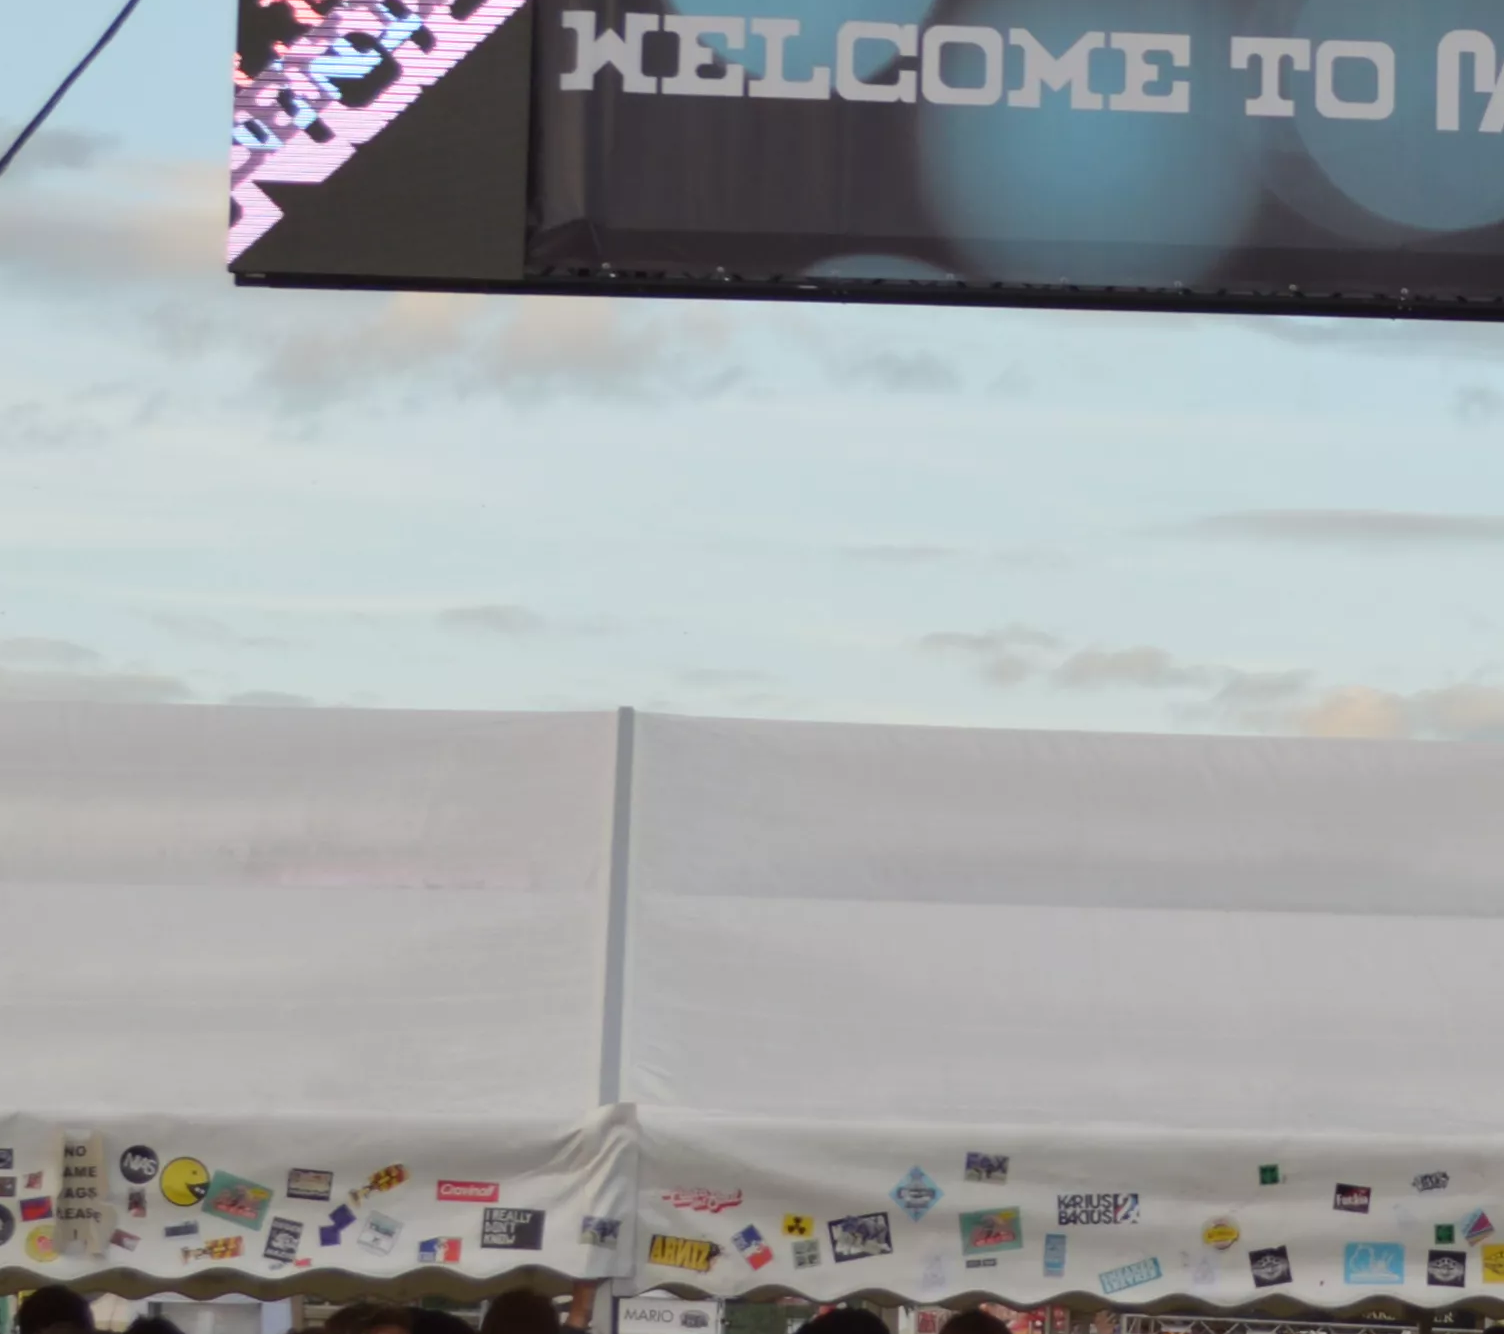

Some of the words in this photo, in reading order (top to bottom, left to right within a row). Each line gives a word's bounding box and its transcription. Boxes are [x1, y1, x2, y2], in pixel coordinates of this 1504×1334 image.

[560, 10, 1191, 114] WELCOME
[1230, 36, 1396, 121] TO
[64, 1146, 87, 1158] NO
[624, 1309, 674, 1324] MARIO
